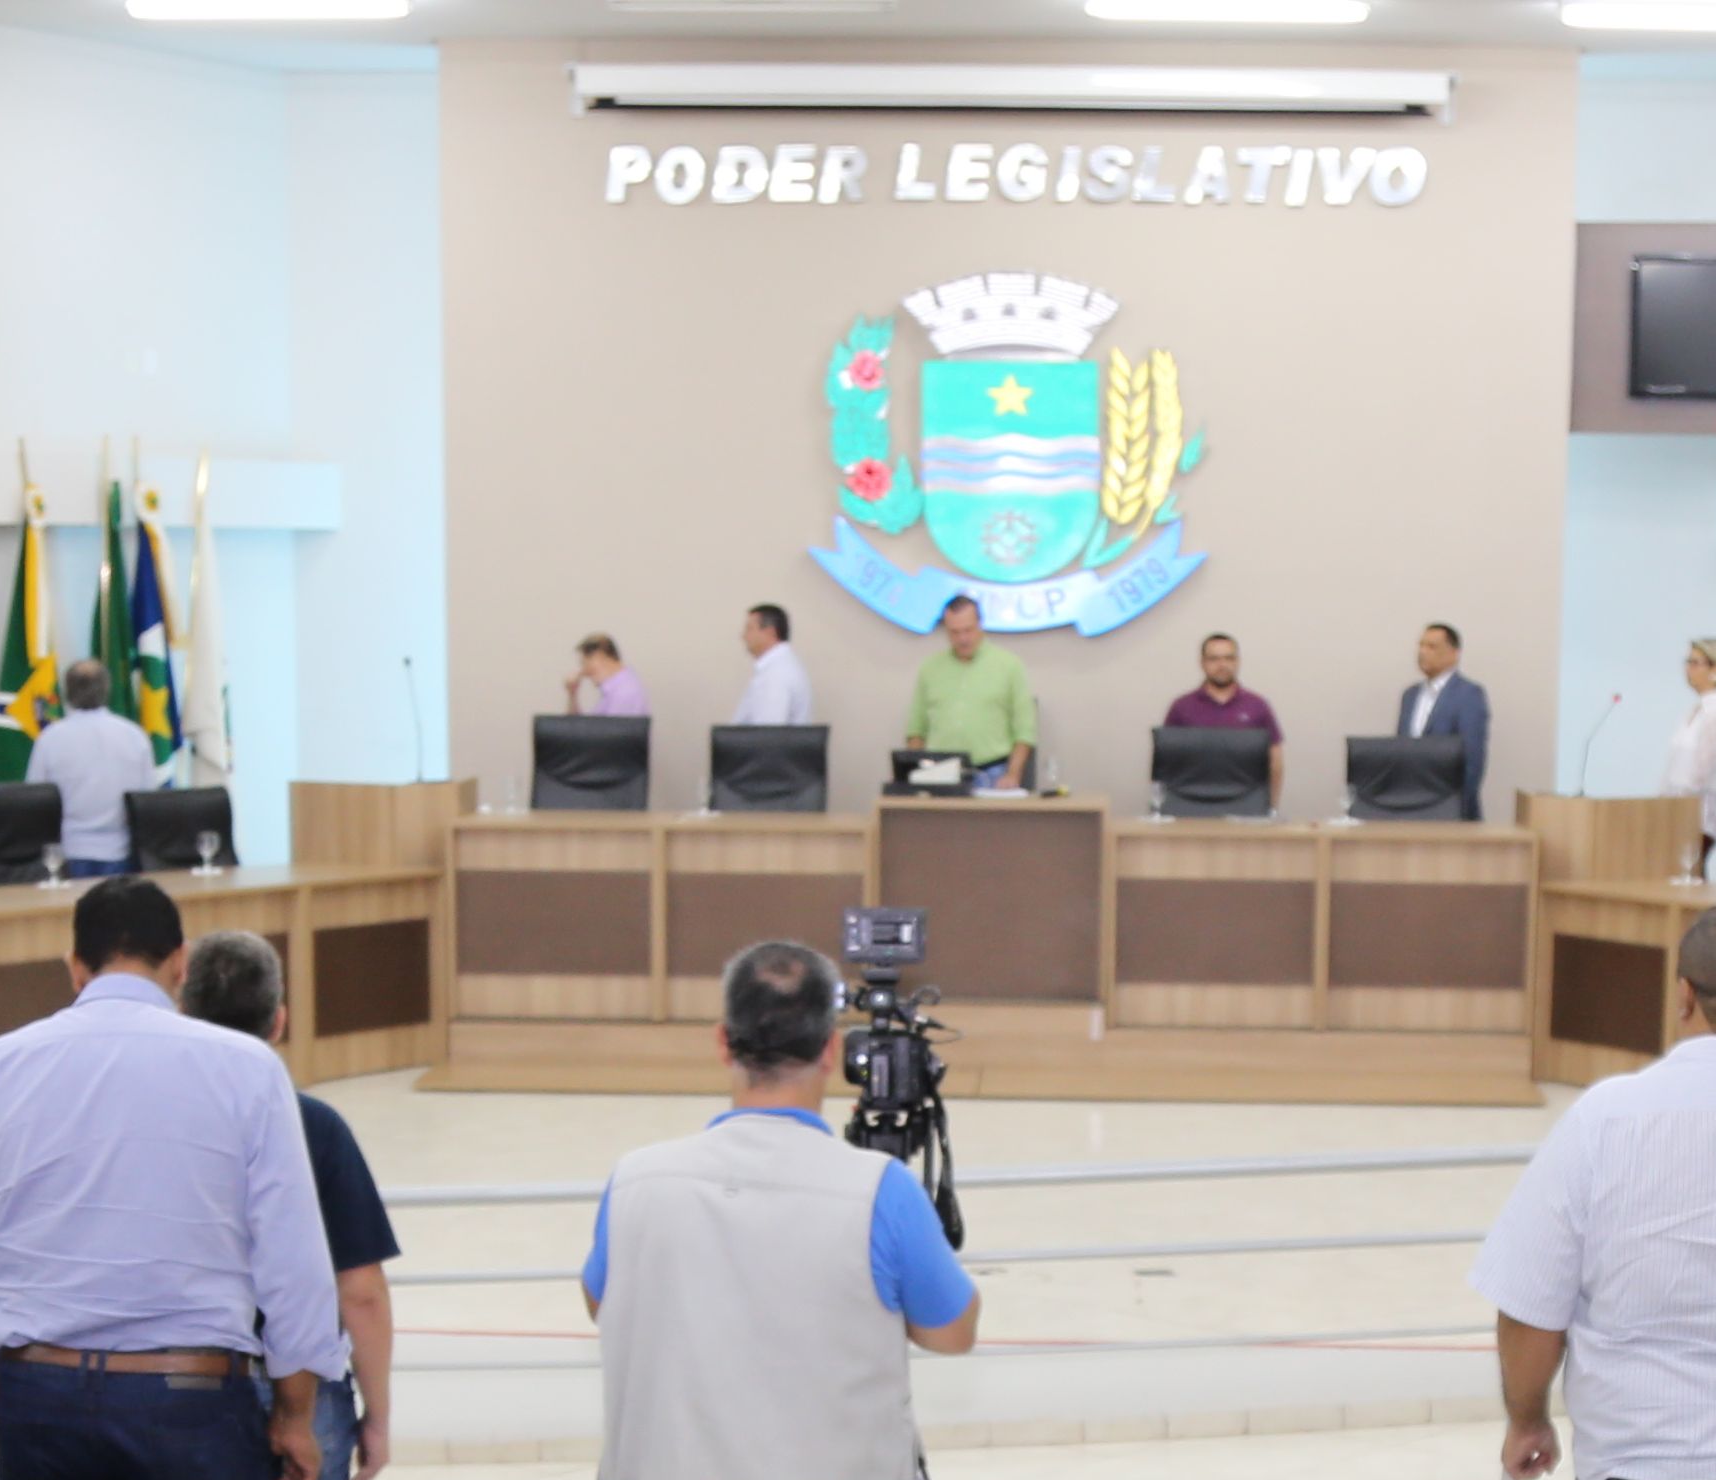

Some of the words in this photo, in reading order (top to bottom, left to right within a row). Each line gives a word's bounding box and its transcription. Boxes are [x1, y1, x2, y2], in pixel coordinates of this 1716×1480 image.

[605, 143, 869, 205] PODER
[893, 142, 1428, 207] LEGISLATIVO
[1106, 557, 1171, 612] 1979
